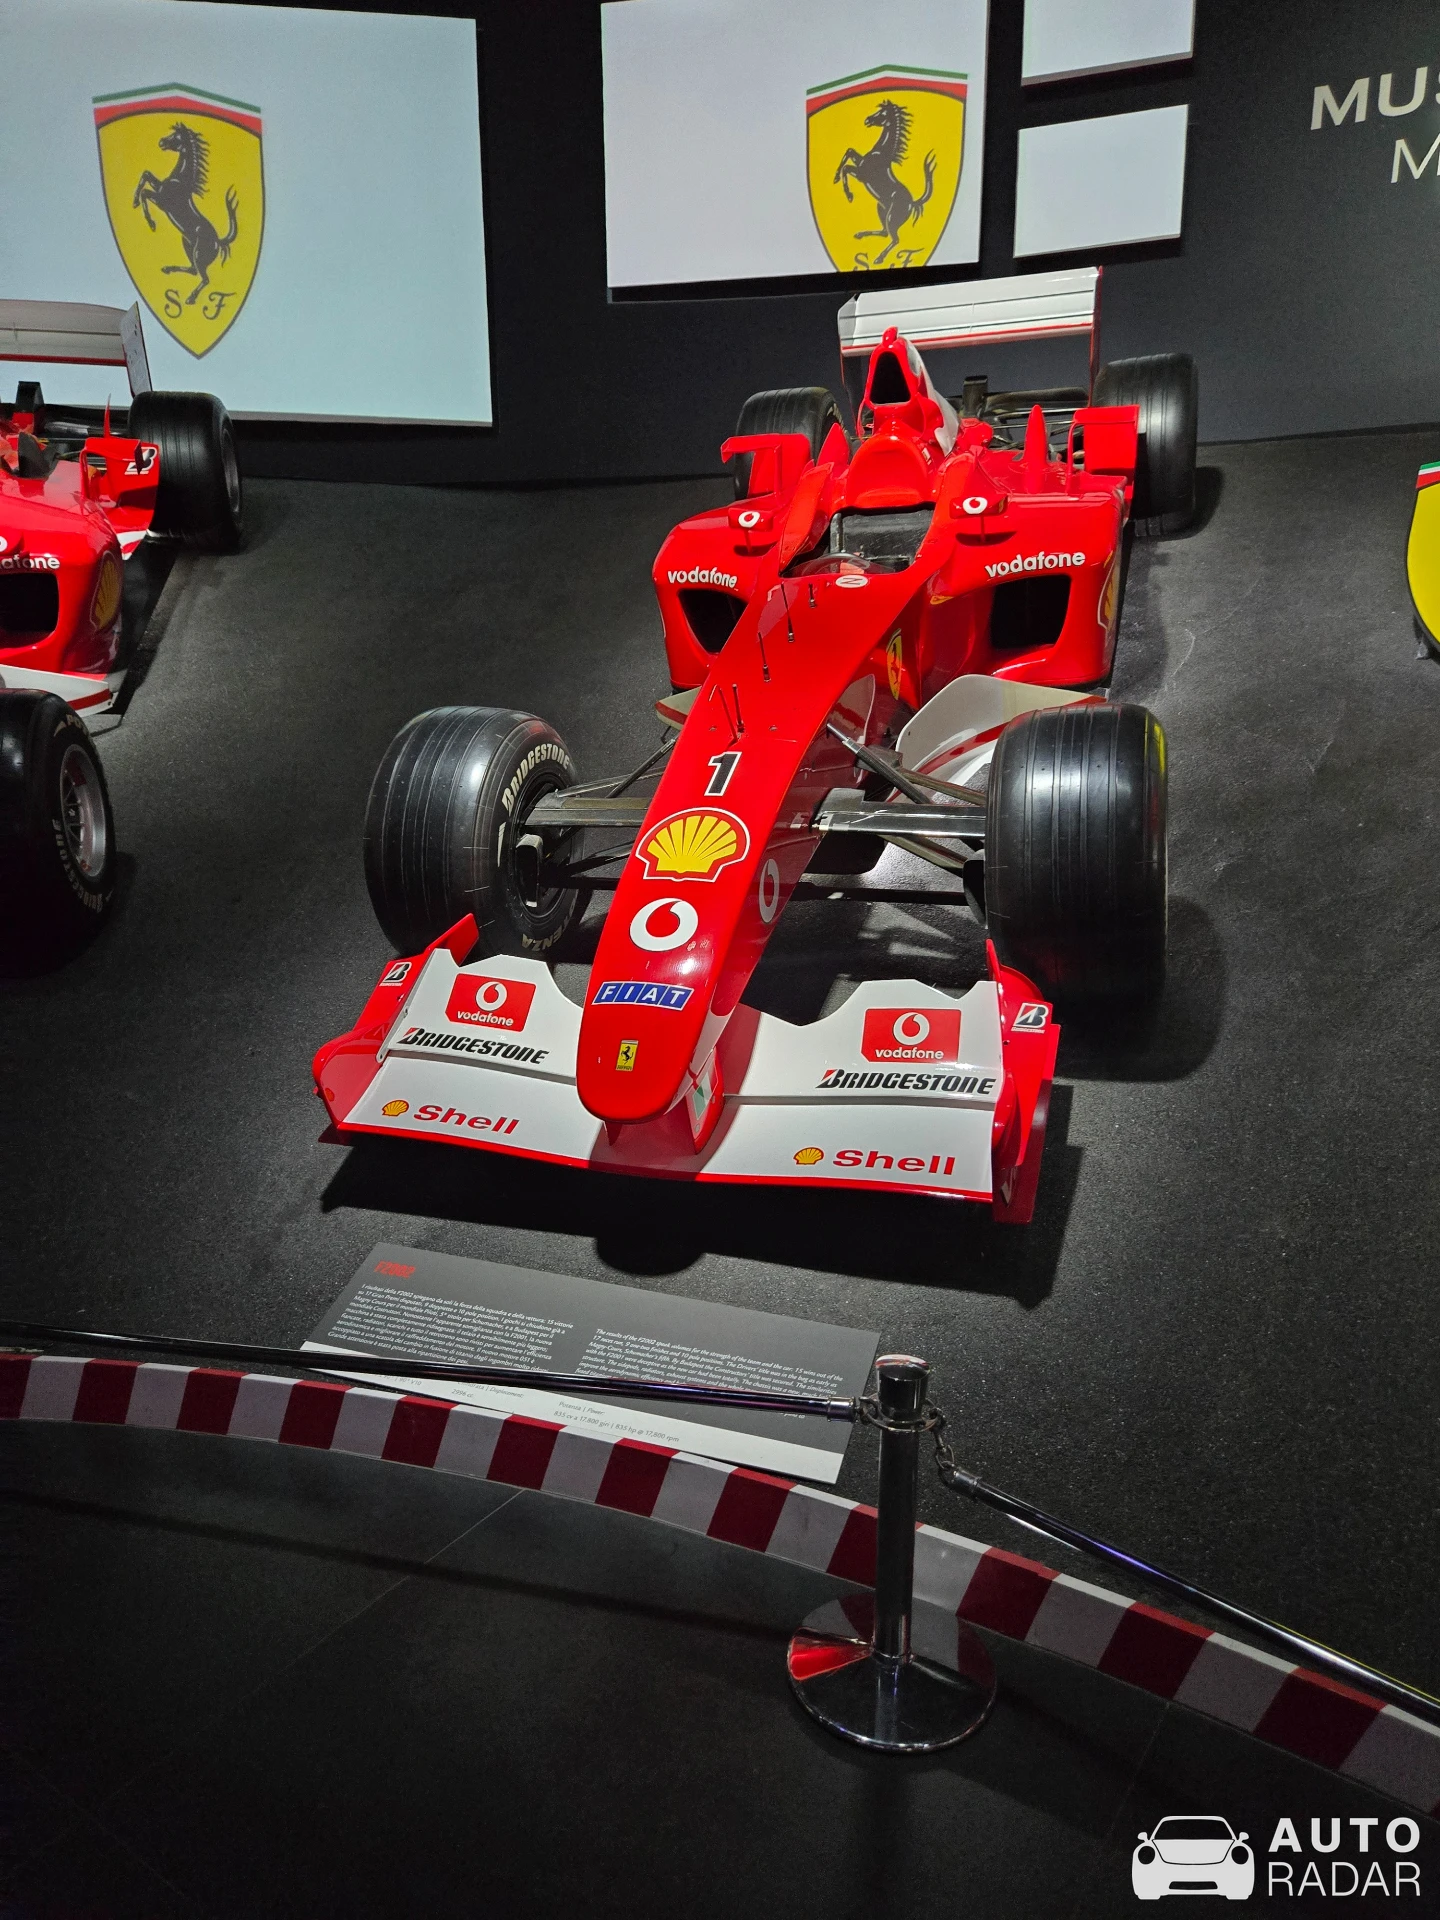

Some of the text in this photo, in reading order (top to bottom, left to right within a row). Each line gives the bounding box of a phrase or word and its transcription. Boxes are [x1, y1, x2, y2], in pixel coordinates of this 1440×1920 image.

[1311, 66, 1440, 131] MU
[164, 289, 182, 319] S
[0, 555, 60, 570] afone
[984, 551, 1086, 578] vodafone
[667, 566, 738, 589] vodafone
[502, 743, 570, 817] BRIDGESTONE
[704, 751, 742, 796] 1
[599, 985, 687, 1006] FIAT
[457, 1010, 514, 1027] vodafone
[397, 1027, 550, 1065] BRIDGESTONE
[875, 1048, 944, 1060] vodafone
[815, 1069, 996, 1095] BRIDGESTONE
[413, 1104, 520, 1135] Shell
[833, 1149, 956, 1176] Shell
[615, 1422, 628, 1431] 835
